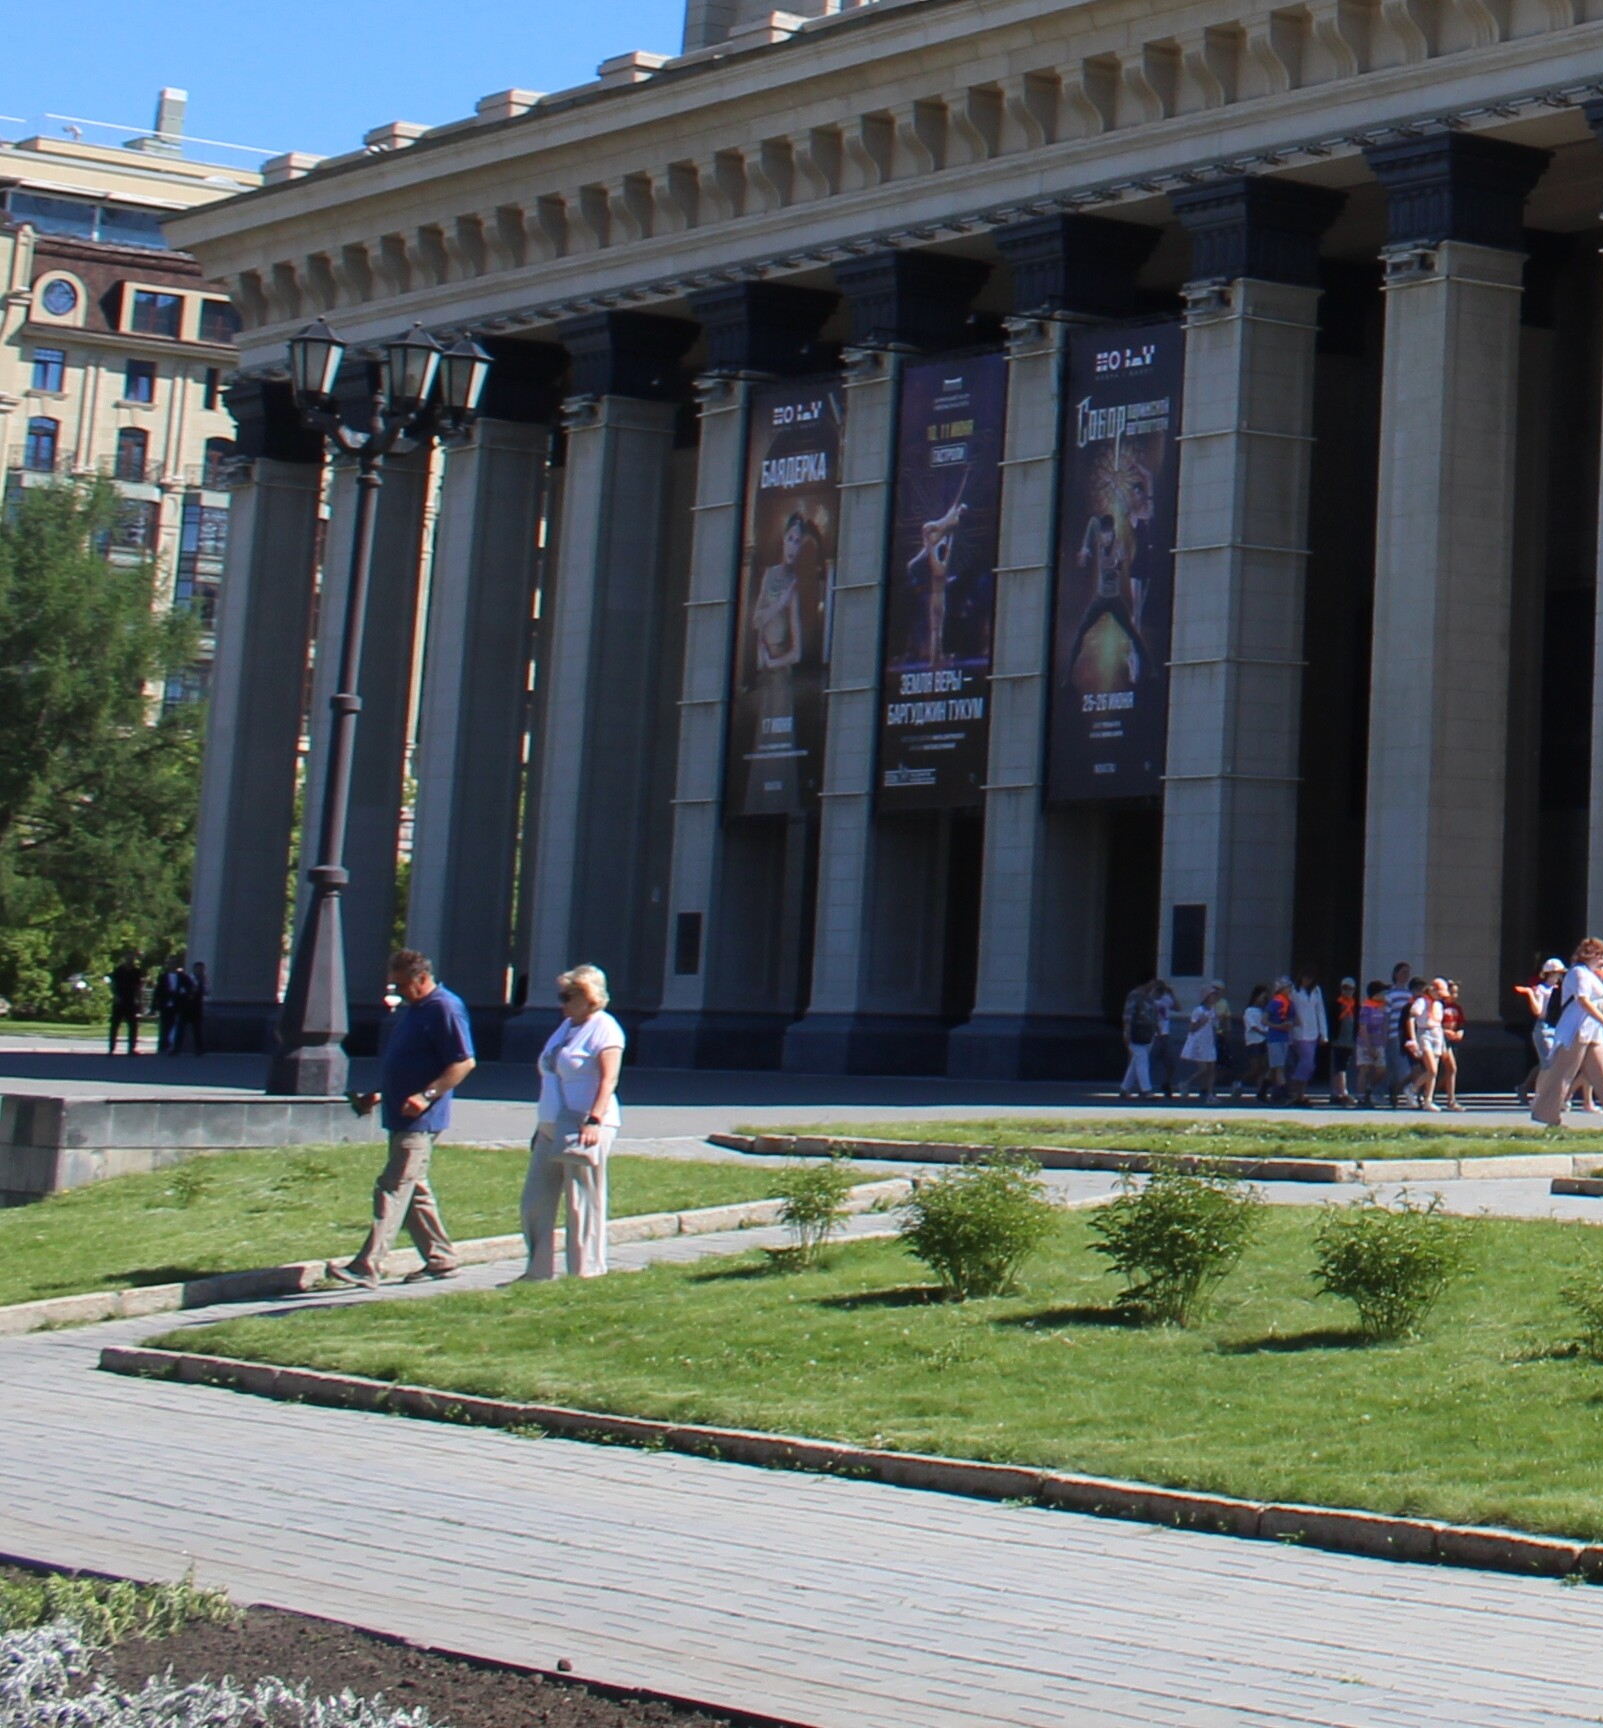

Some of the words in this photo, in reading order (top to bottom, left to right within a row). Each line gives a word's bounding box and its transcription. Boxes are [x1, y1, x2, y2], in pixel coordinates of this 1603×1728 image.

[760, 452, 826, 489] БАЯДЕРКА
[900, 672, 933, 695] ЗЕМЛЯ
[934, 669, 962, 693] ВЕРЫ
